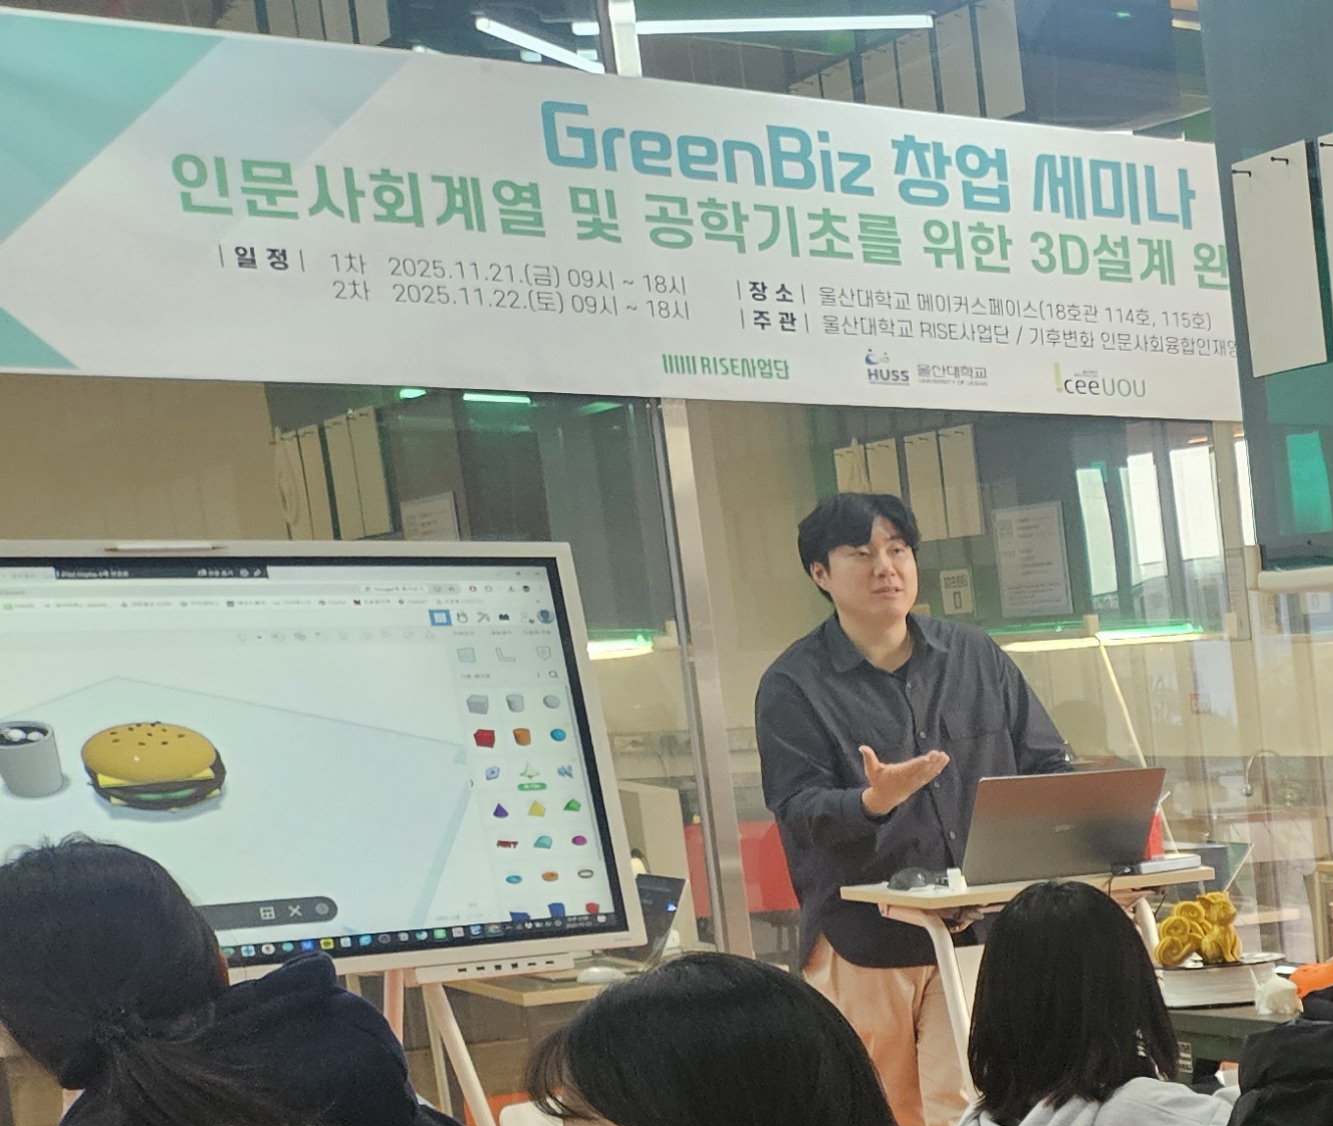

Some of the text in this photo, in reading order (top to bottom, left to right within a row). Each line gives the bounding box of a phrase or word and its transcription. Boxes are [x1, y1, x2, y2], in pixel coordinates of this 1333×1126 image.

[541, 100, 1196, 230] GreenBiz 창업 세미나
[171, 153, 547, 238] 인문사회계열
[568, 185, 623, 244] 및
[645, 189, 902, 266] 공학기초를
[923, 219, 1013, 275] 위한
[1030, 231, 1176, 286] 3D설계
[330, 253, 367, 275] 1차
[332, 280, 370, 301] 2차
[819, 286, 911, 311] 울산대학교
[1162, 311, 1212, 332] 115호)
[823, 315, 914, 338] 울산대학교
[920, 321, 1009, 346] RISE사업단
[1030, 327, 1095, 349] 기후변화
[867, 368, 910, 381] HUSS
